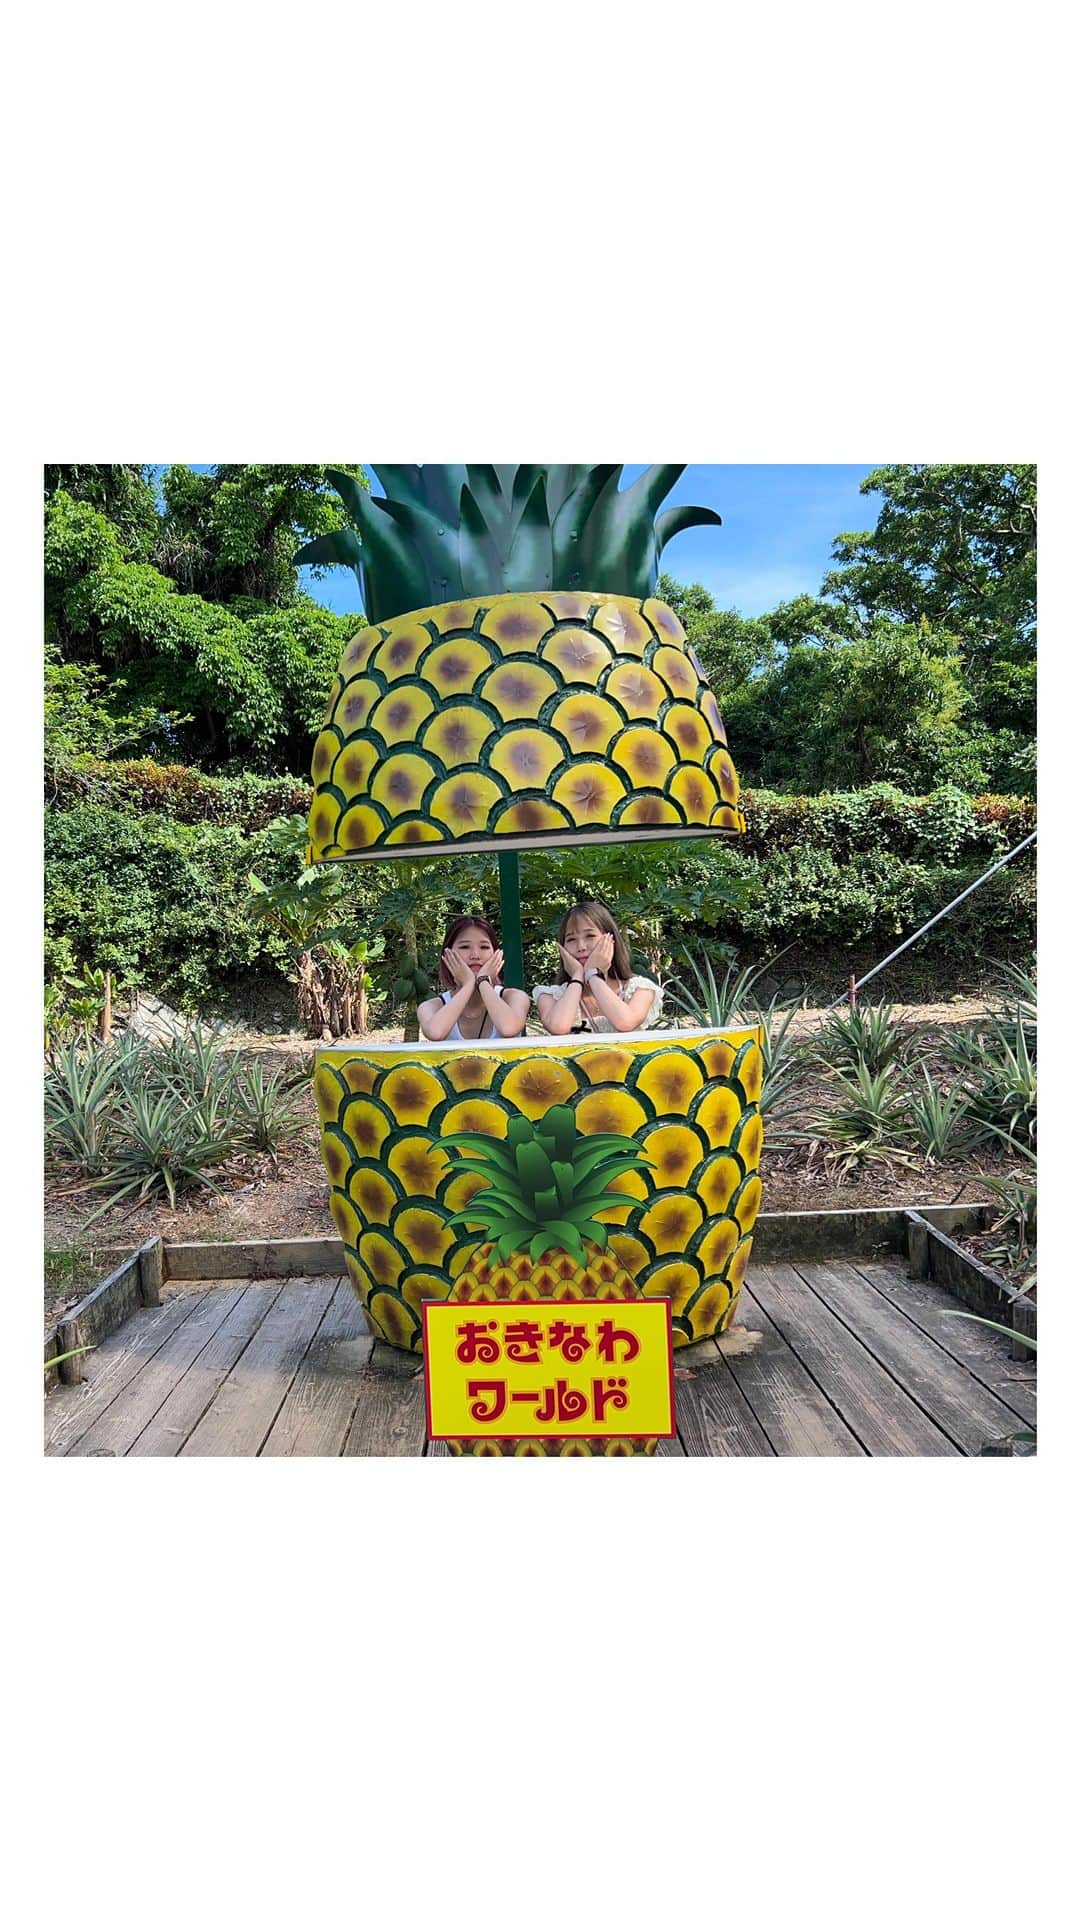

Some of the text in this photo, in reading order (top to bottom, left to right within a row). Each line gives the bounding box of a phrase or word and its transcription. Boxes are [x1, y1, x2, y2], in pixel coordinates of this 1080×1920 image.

[455, 1319, 641, 1364] おきなわ
[466, 1378, 629, 1423] ワールド
